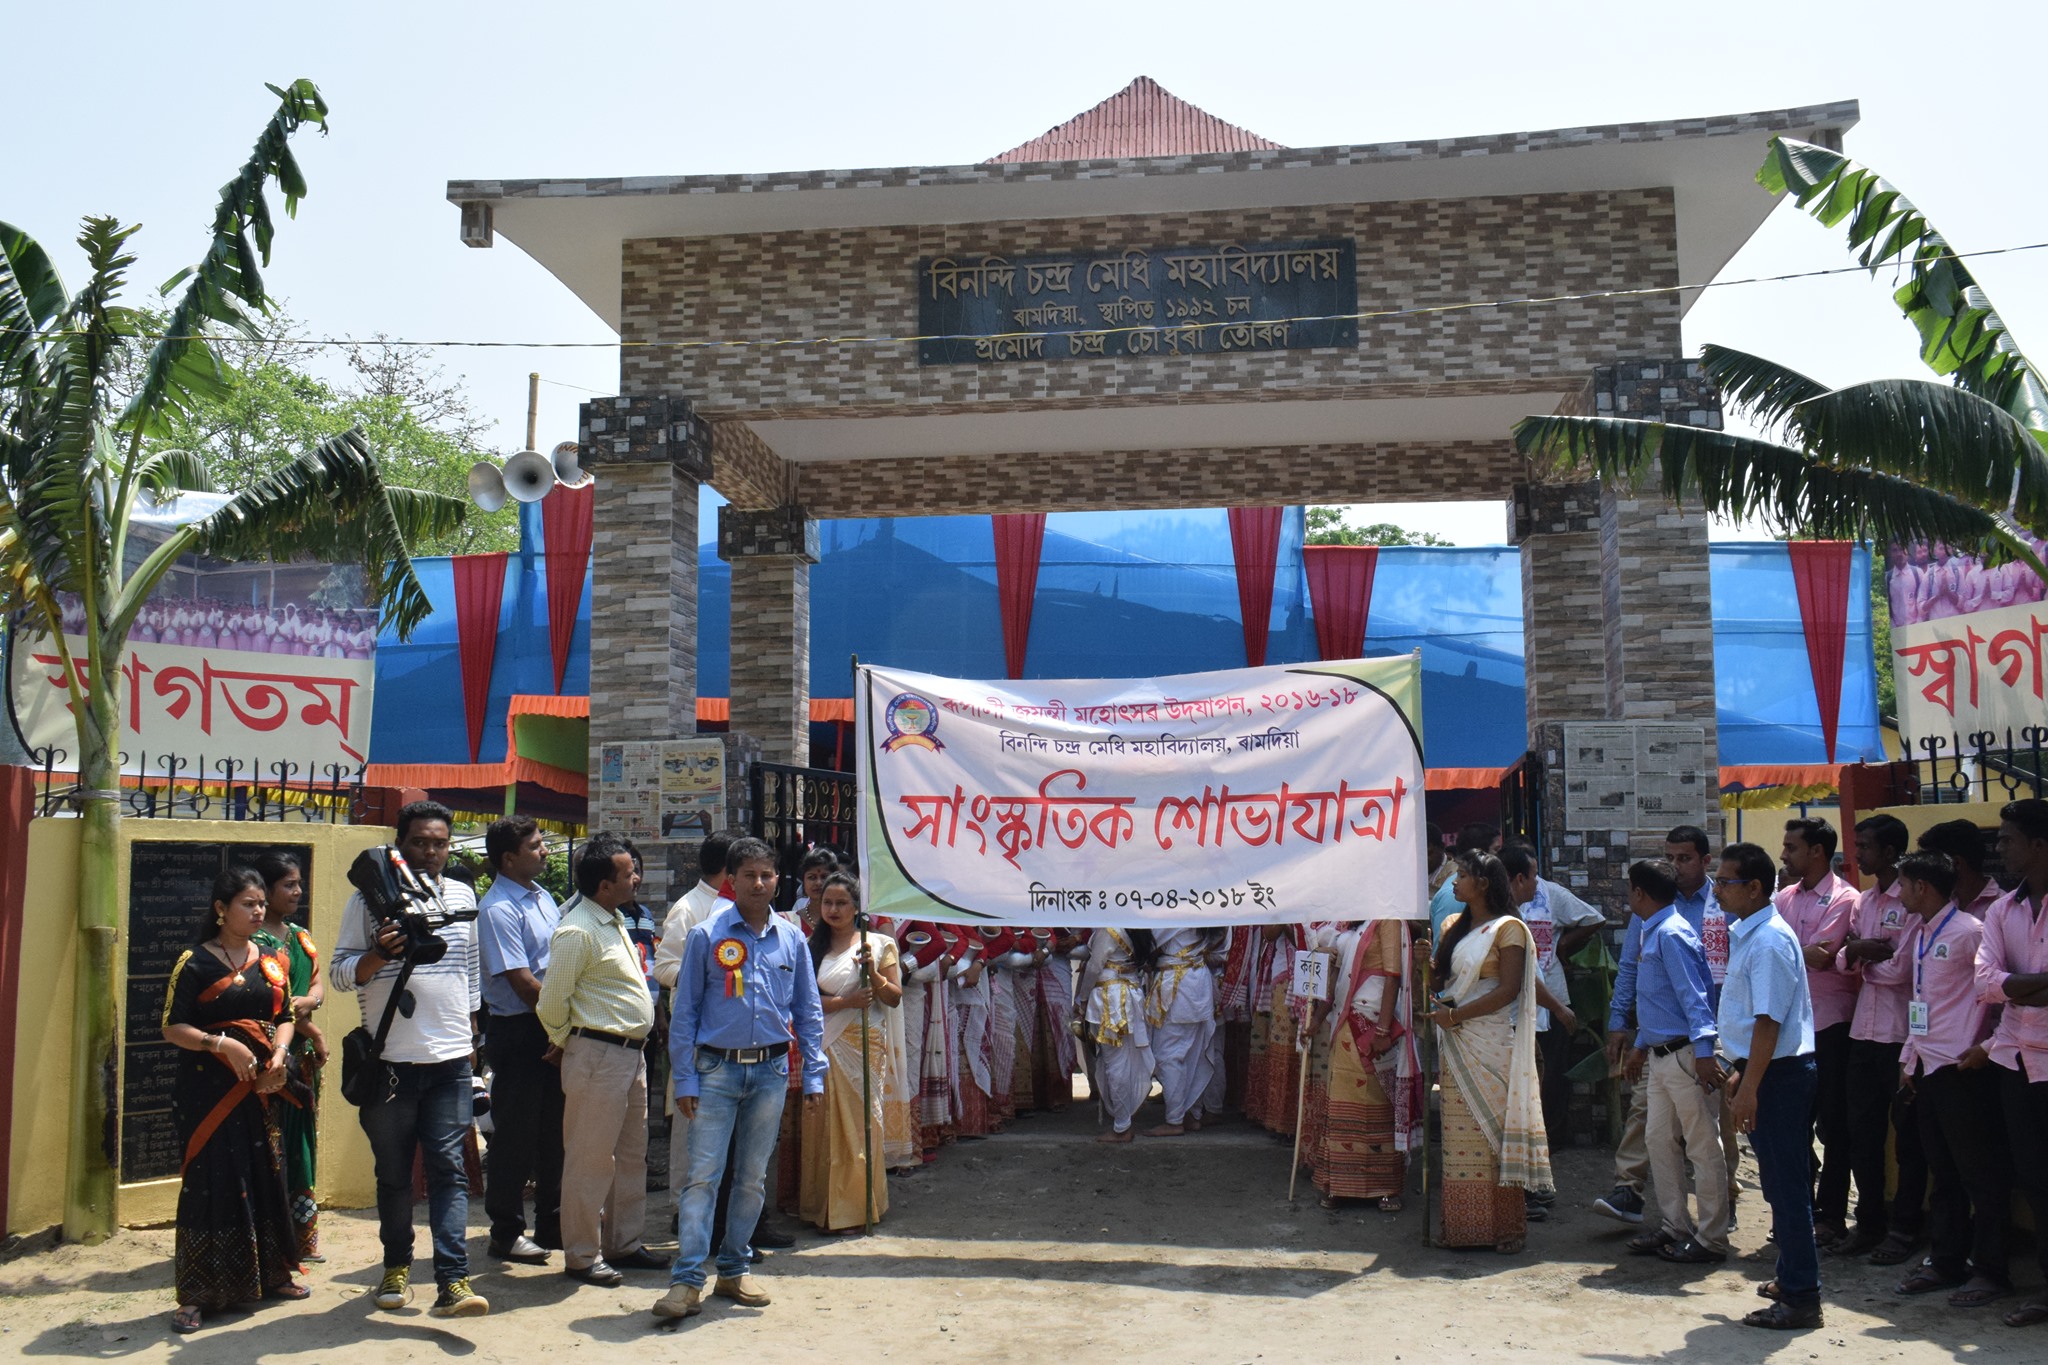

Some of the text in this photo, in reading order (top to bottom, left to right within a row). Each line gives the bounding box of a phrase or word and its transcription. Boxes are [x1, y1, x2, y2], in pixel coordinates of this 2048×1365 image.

[927, 243, 1339, 299] বিনন্দি চন্দ্ৰ মেধি মহাবিদ্যালয়
[1097, 295, 1155, 326] স্থাপিত
[1166, 296, 1218, 318] ১৯৯২
[1225, 297, 1250, 316] চন
[1260, 687, 1359, 713] ২০১৬-১৮
[999, 726, 1301, 756] বিনন্দি চন্দ্ৰ মেধি মহাবিদ্যালয়, ৰামদিয়া
[899, 768, 1408, 872] সাংস্কৃতিক শোভাযাত্ৰা
[1028, 881, 1094, 913] দিনাংক
[1114, 887, 1245, 911] ০৭-০৪-২০১৮
[1246, 879, 1277, 911] ইং
